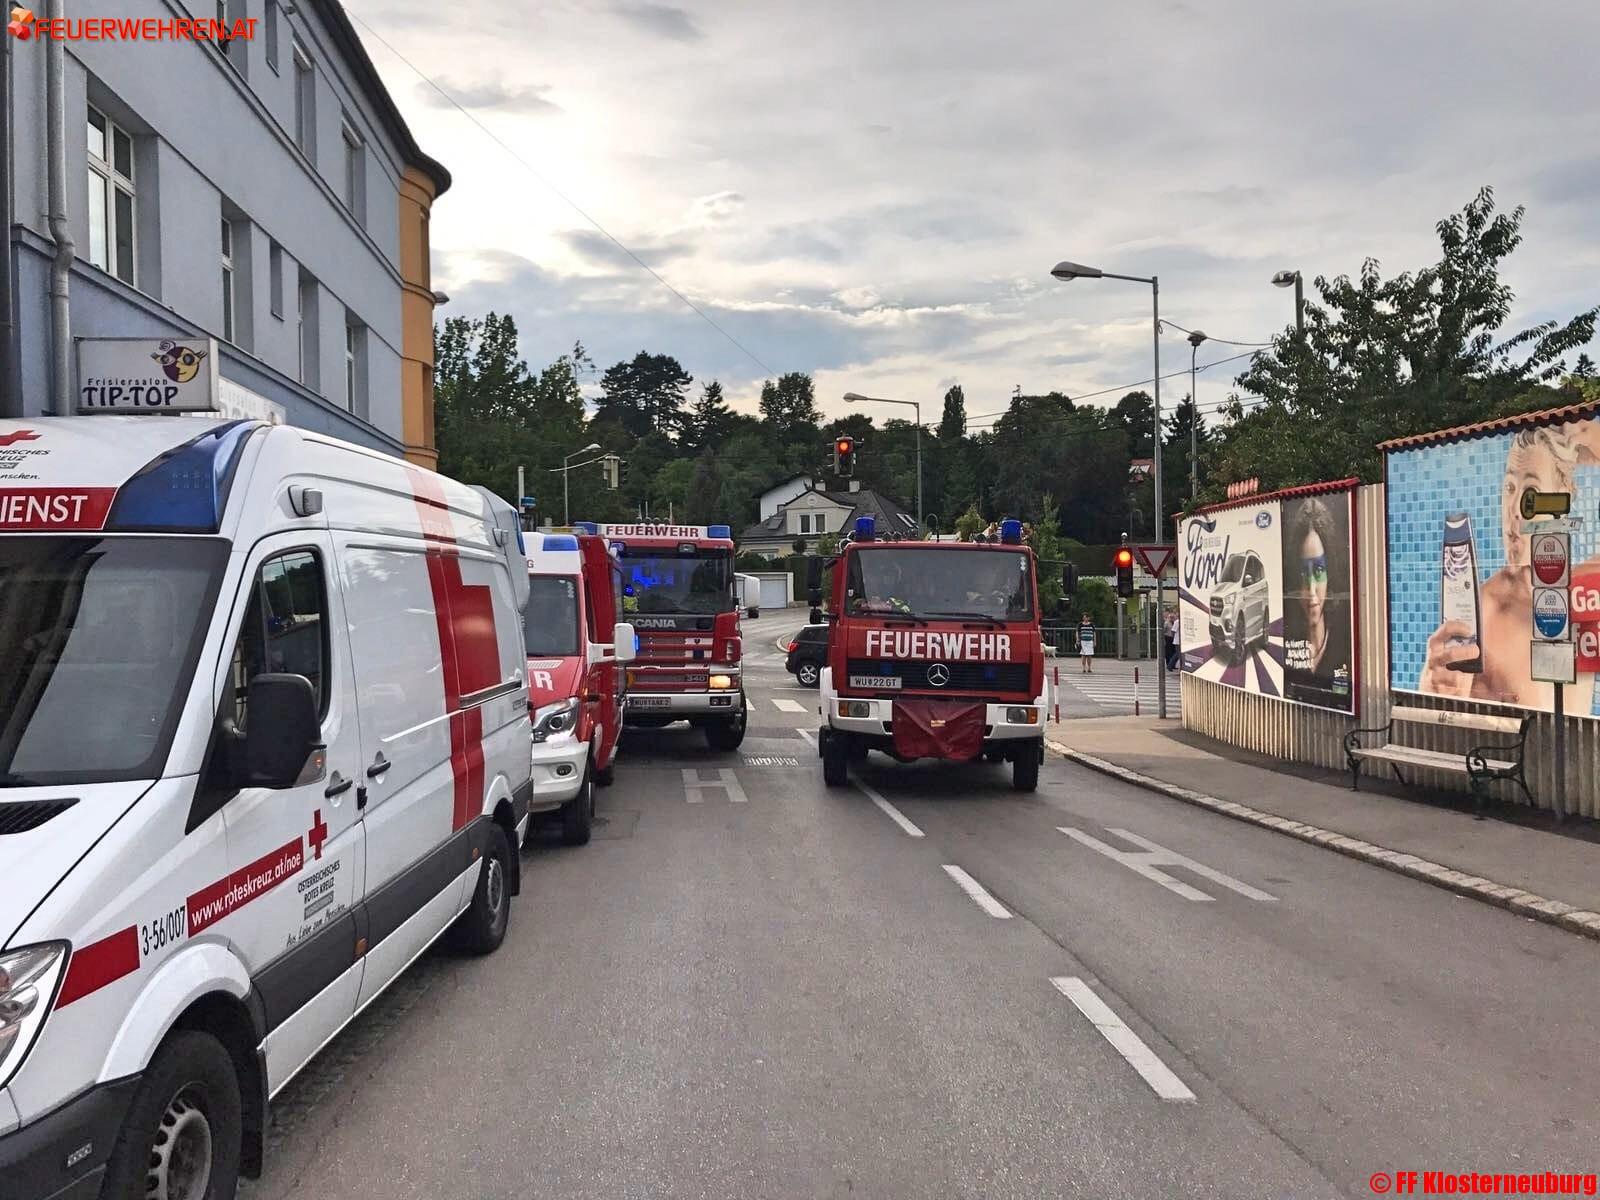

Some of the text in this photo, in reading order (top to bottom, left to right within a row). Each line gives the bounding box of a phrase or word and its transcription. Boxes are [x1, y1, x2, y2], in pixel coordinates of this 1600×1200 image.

[82, 386, 178, 406] TIP-TOP
[88, 377, 168, 386] Frisiersalon
[606, 525, 699, 538] FEUERWEHR
[1184, 518, 1230, 589] Ford
[866, 630, 1011, 661] FEUERWEHR
[191, 852, 301, 927] www.roteskreuz.at/noe
[142, 905, 186, 956] 3-56/007
